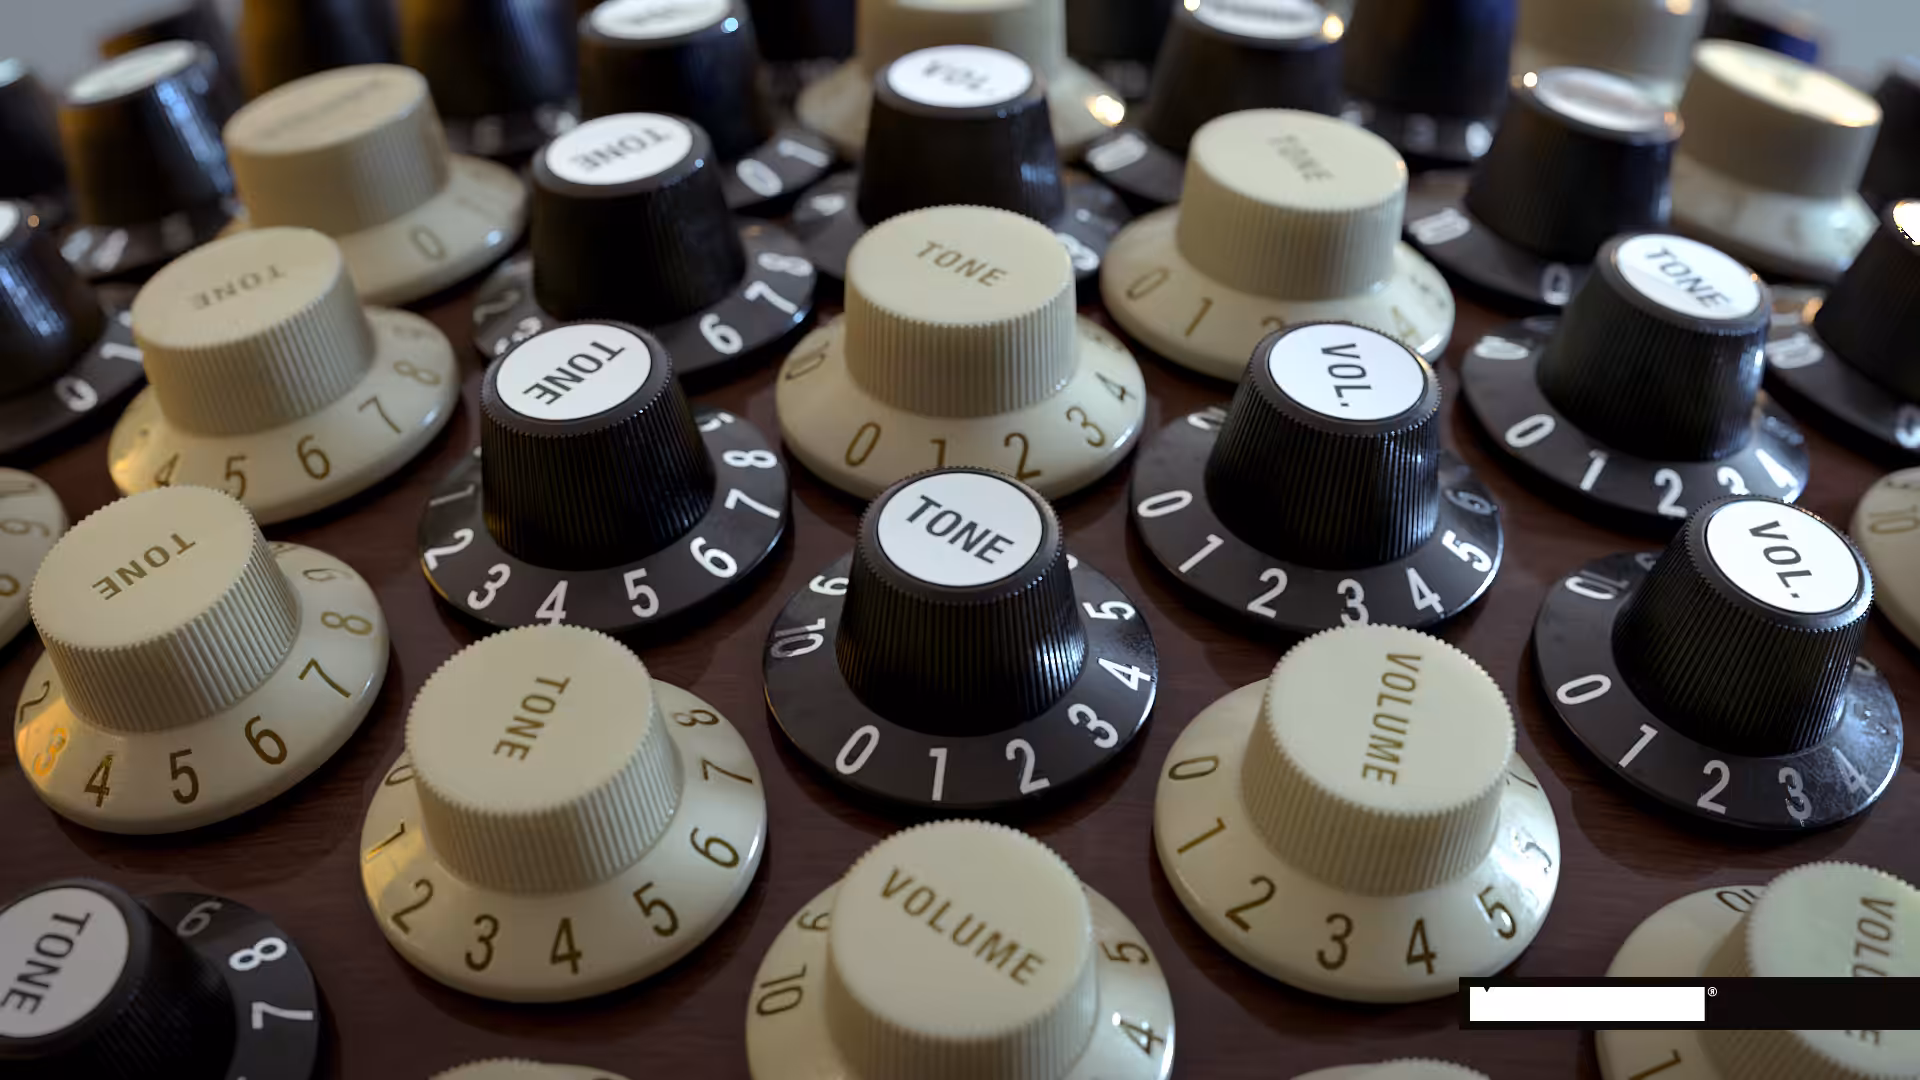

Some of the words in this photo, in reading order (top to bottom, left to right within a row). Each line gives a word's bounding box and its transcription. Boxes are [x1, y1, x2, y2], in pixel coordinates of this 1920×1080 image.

[569, 127, 675, 173] TONE
[917, 239, 1008, 288] TONE
[1126, 265, 1171, 302] 0
[1646, 246, 1731, 310] TONE
[187, 263, 287, 311] TONE
[744, 280, 802, 318] 7
[700, 313, 743, 355] 6
[1184, 296, 1214, 338] 1
[392, 359, 442, 386] 8
[522, 339, 627, 406] TONE
[1321, 341, 1373, 408] VOL.
[357, 394, 403, 434] 7
[1066, 406, 1106, 448] 3
[1505, 413, 1556, 448] 0
[297, 433, 331, 481] 6
[722, 449, 778, 469] 8
[845, 421, 881, 467] 0
[1004, 432, 1042, 481] 2
[224, 454, 248, 499] 5
[1579, 449, 1609, 491] 1
[1654, 467, 1688, 518] 2
[430, 484, 475, 507] 1
[725, 488, 780, 520] 7
[1137, 489, 1193, 518] 0
[424, 528, 475, 571] 2
[905, 494, 1016, 565] TONE
[1441, 530, 1492, 573] 5
[92, 533, 196, 600] TONE
[690, 537, 738, 579] 6
[1178, 533, 1225, 574] 1
[1748, 519, 1814, 599] VOL.
[467, 563, 511, 610] 3
[535, 580, 568, 625] 4
[624, 568, 660, 618] 5
[1248, 567, 1288, 618] 2
[1337, 579, 1369, 627] 3
[1406, 567, 1445, 617] 4
[320, 611, 373, 636] 8
[1082, 600, 1136, 621] 5
[770, 617, 826, 659] 10
[298, 658, 352, 699] 7
[1097, 656, 1153, 691] 4
[1556, 673, 1612, 705] 0
[244, 715, 288, 765] 6
[493, 675, 571, 762] TONE
[670, 708, 720, 729] 8
[1067, 703, 1119, 749] 3
[1361, 651, 1423, 786] VOLUME
[33, 727, 67, 777] 3
[835, 725, 880, 775] 0
[1005, 738, 1050, 795] 2
[1168, 755, 1219, 781] 0
[1618, 724, 1658, 768] 1
[84, 754, 114, 808] 4
[169, 748, 199, 804] 5
[701, 757, 753, 785] 7
[928, 747, 948, 802] 1
[1696, 759, 1731, 815] 2
[1778, 767, 1812, 824] 3
[365, 818, 406, 862] 1
[690, 827, 740, 869] 6
[1177, 817, 1227, 855] 1
[391, 878, 434, 935] 2
[632, 882, 680, 938] 5
[880, 867, 1044, 987] VOLUME
[1225, 875, 1276, 933] 2
[1477, 886, 1518, 941] 5
[0, 911, 92, 1015] TONE
[229, 936, 288, 971] 8
[465, 914, 499, 972] 3
[549, 917, 583, 975] 4
[1101, 941, 1149, 965] 5
[1316, 913, 1354, 971] 3
[1406, 918, 1437, 976] 4
[756, 964, 807, 1017] 10
[251, 1001, 314, 1030] 7
[1112, 1012, 1164, 1056] 4
